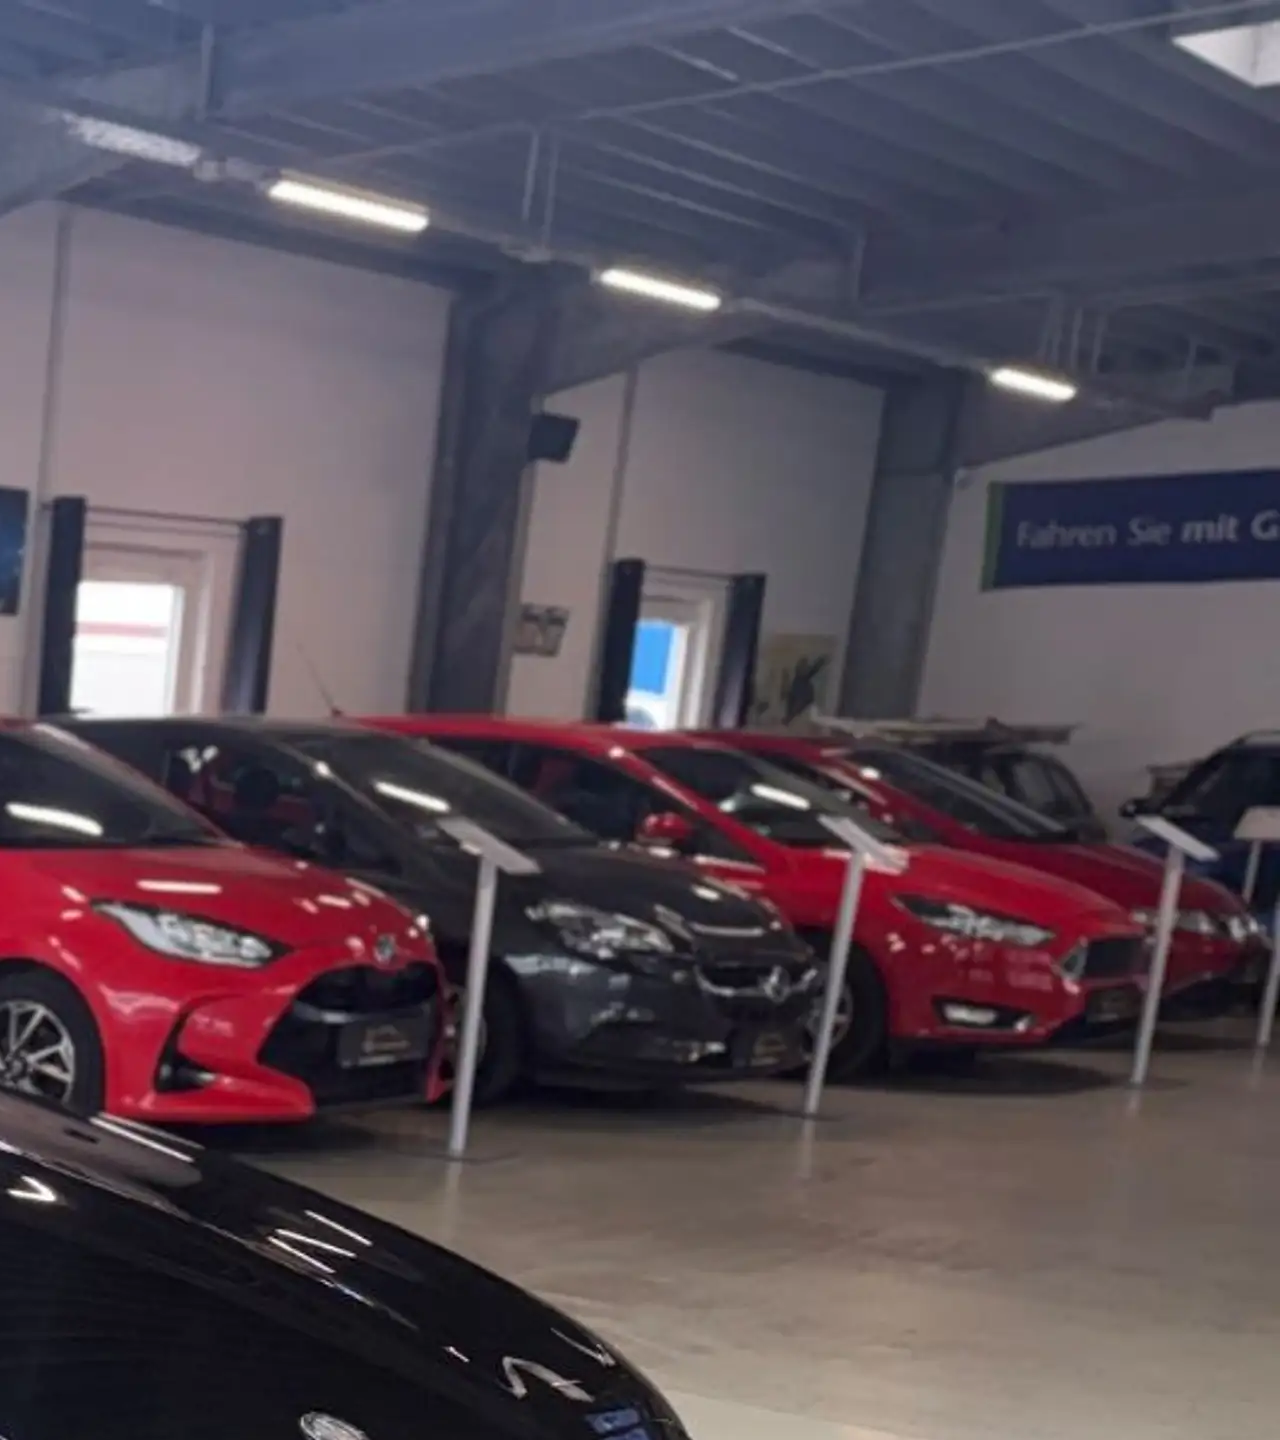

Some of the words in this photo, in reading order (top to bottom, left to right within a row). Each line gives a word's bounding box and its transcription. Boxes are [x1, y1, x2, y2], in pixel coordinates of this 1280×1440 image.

[1017, 520, 1117, 548] Fahren
[1127, 516, 1171, 545] Sie
[1181, 514, 1239, 542] mit
